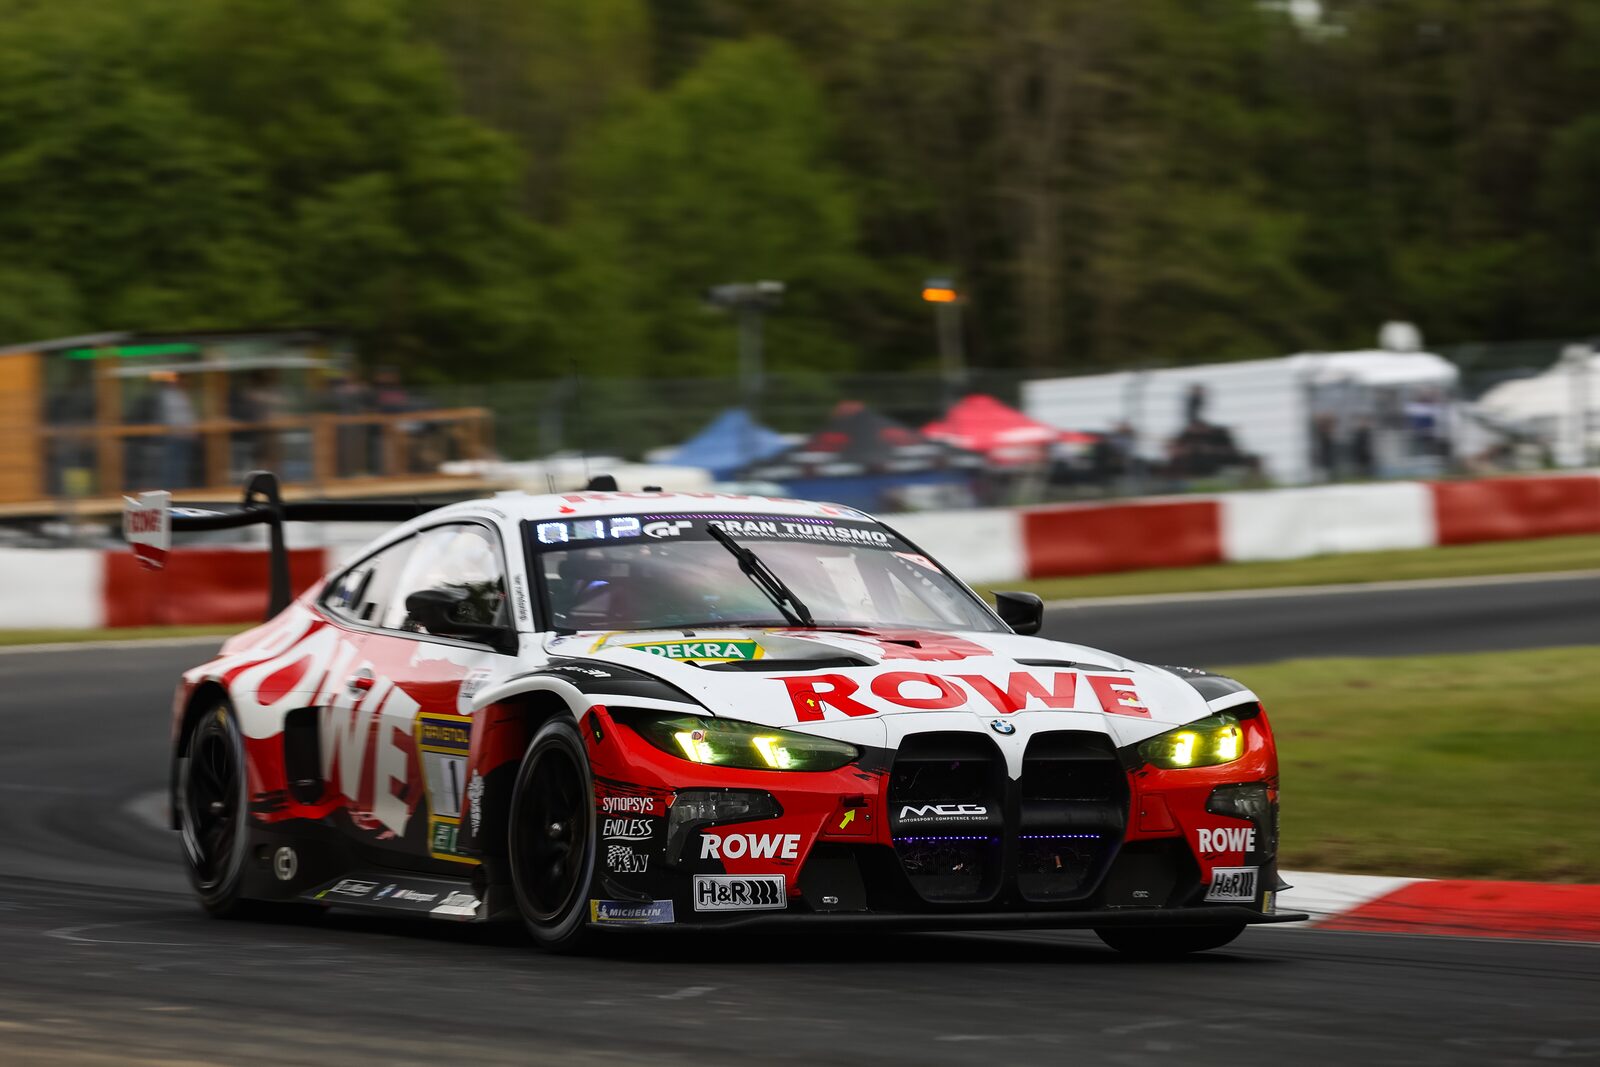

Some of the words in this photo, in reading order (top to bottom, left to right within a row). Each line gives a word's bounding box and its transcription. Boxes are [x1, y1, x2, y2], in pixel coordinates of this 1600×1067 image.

[707, 520, 778, 533] GRAN
[780, 522, 889, 543] TURISMO
[645, 643, 745, 658] DEKRA
[763, 671, 1152, 722] ROWE
[602, 797, 654, 814] SYNOPSYS
[899, 804, 987, 819] MCG
[602, 819, 654, 836] ENDLESS
[700, 833, 801, 859] ROWE
[1196, 828, 1256, 853] ROWE
[613, 854, 649, 873] KW
[698, 880, 750, 905] H&R
[1210, 873, 1240, 897] H&R
[608, 908, 662, 917] MICHELIN
